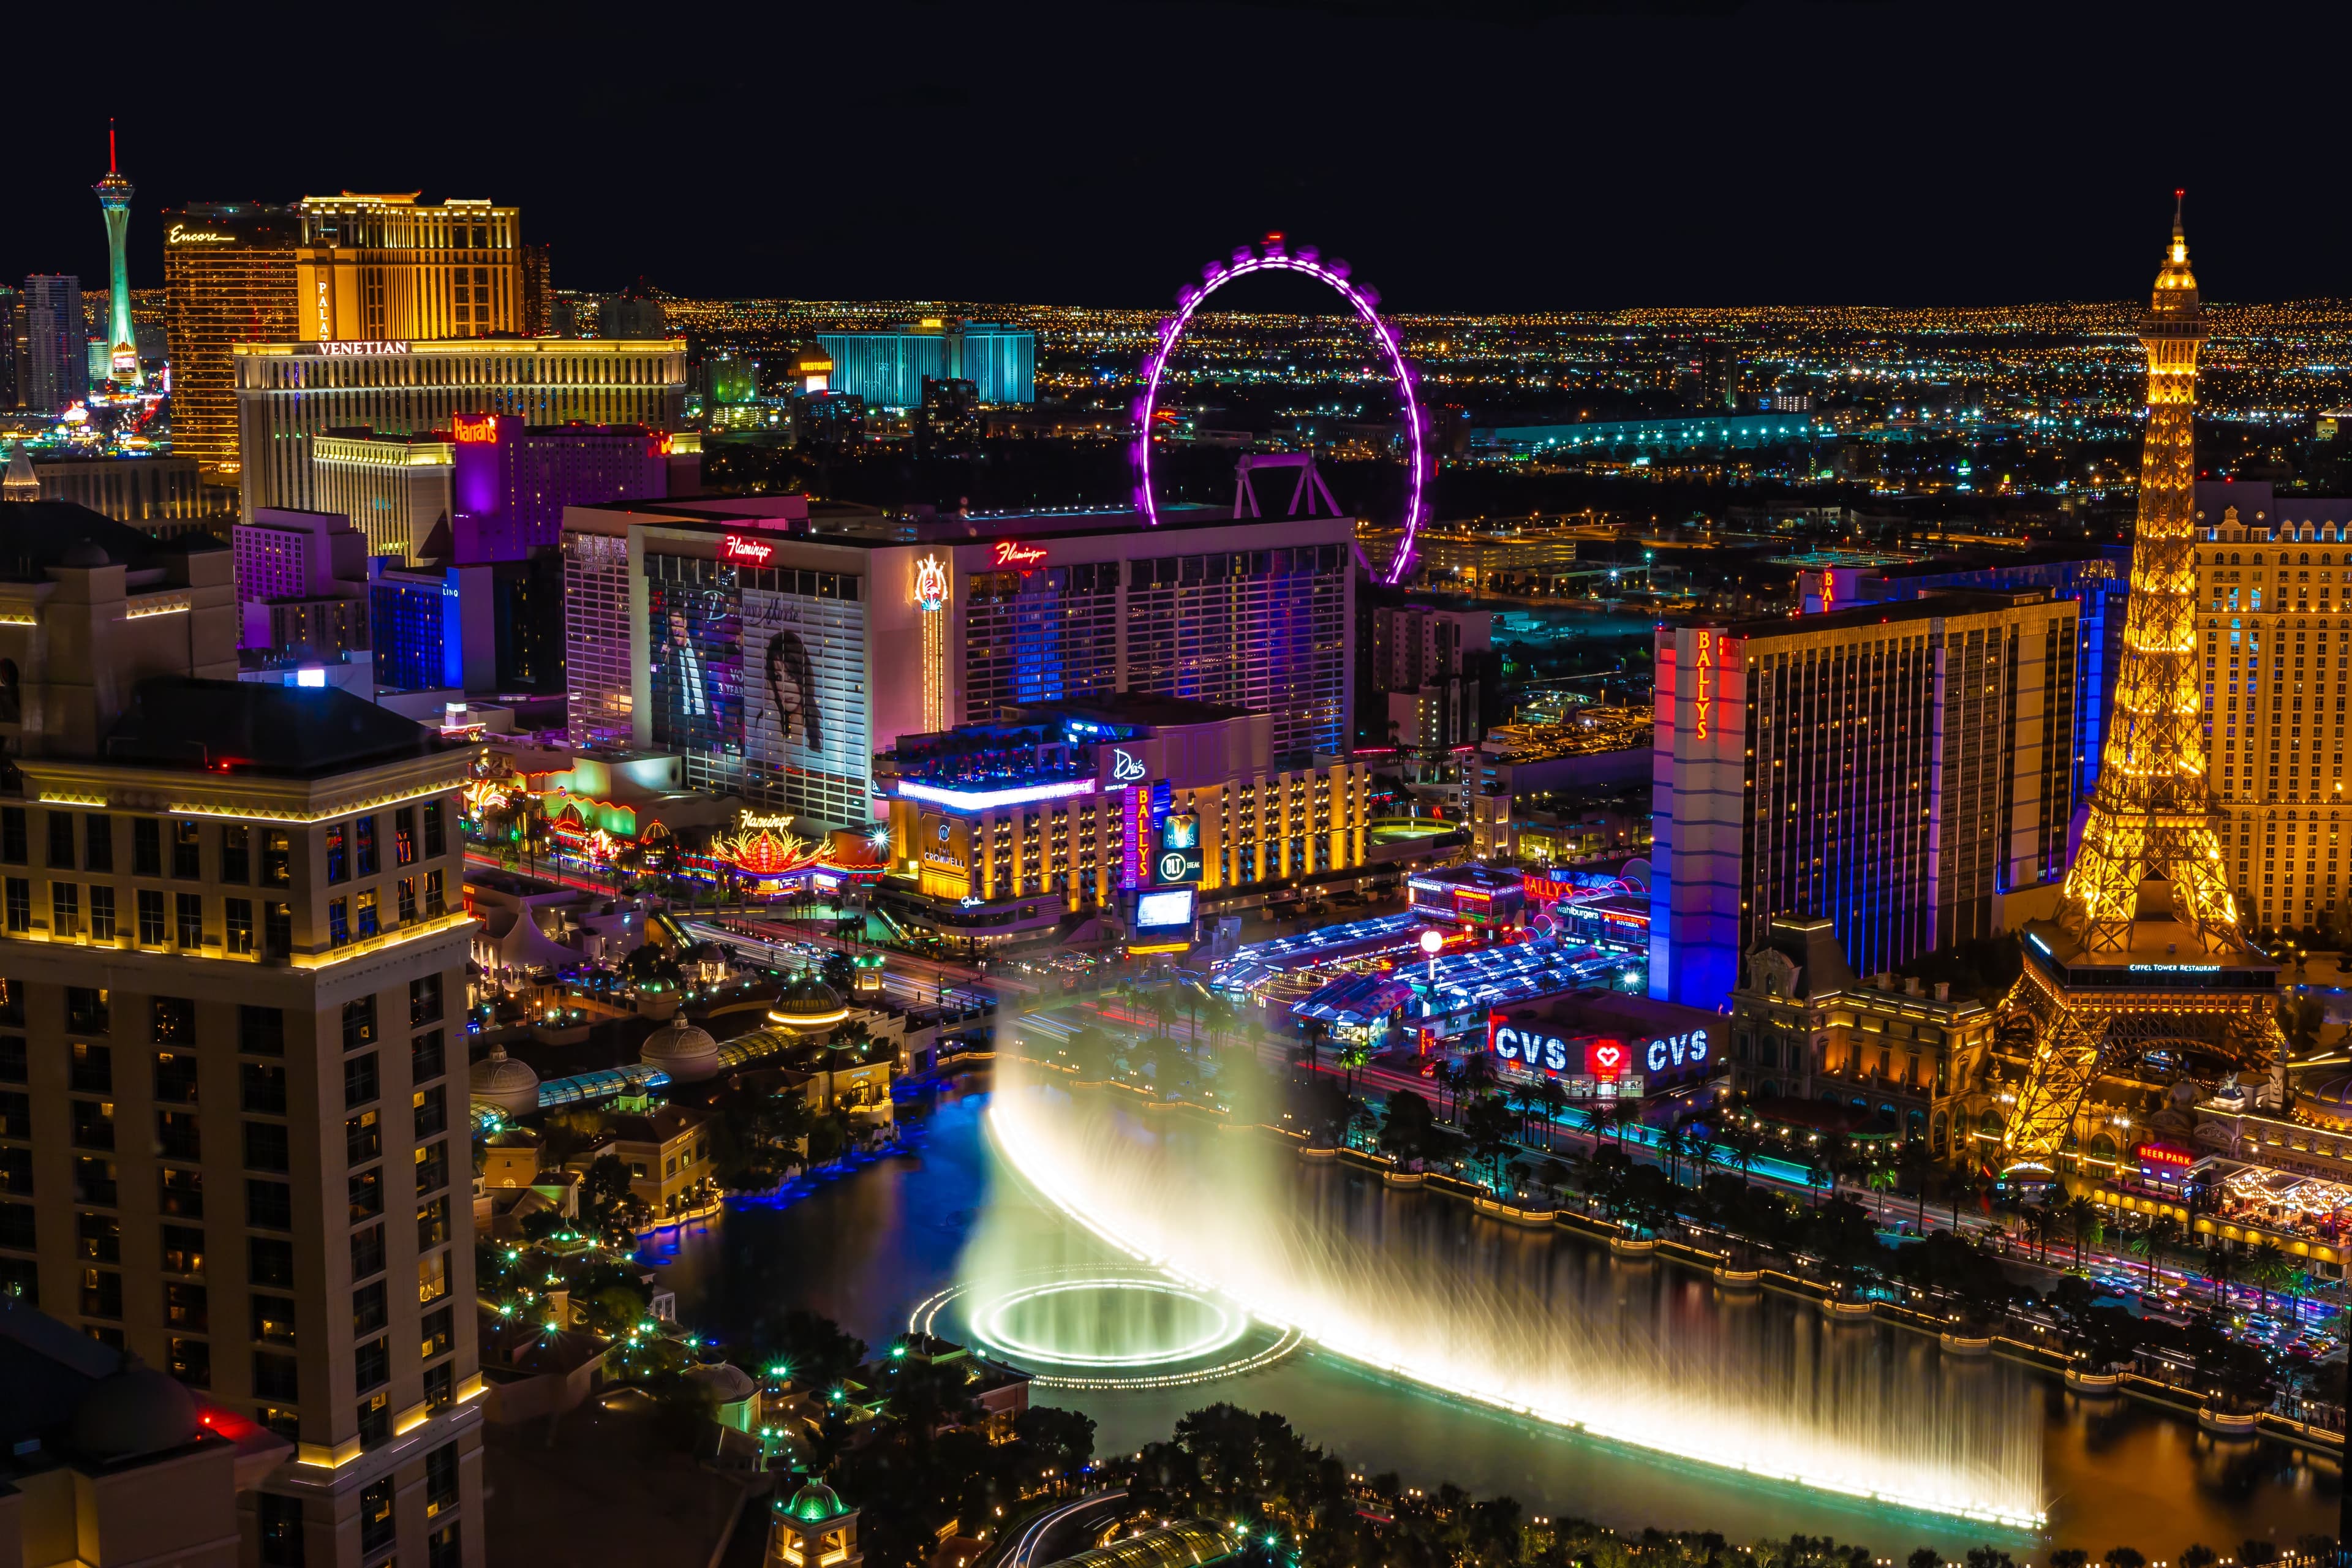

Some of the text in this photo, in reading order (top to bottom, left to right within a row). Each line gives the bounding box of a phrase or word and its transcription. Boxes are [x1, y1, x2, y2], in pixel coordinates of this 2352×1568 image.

[170, 224, 235, 243] Encore
[318, 341, 407, 355] VENETIAN
[800, 361, 832, 371] WESTGATE
[726, 535, 772, 563] Flamingo
[996, 542, 1047, 565] Flamingo
[443, 588, 458, 597] LINQ
[1695, 631, 1711, 739] BALLYS
[741, 809, 794, 834] Flamingo
[1137, 790, 1149, 876] BALLYS
[924, 852, 965, 869] CROMWELL
[1166, 859, 1180, 875] BLT
[1408, 880, 1441, 892] STARBUCKS
[1524, 875, 1574, 897] BALLY'S
[1556, 906, 1599, 919] wahlburgers
[1610, 914, 1646, 925] REDNECK
[1616, 920, 1639, 929] RIVIERA
[1496, 1028, 1566, 1069] CVS
[1648, 1030, 1707, 1071] CVS
[2141, 1147, 2190, 1166] BEER PARK
